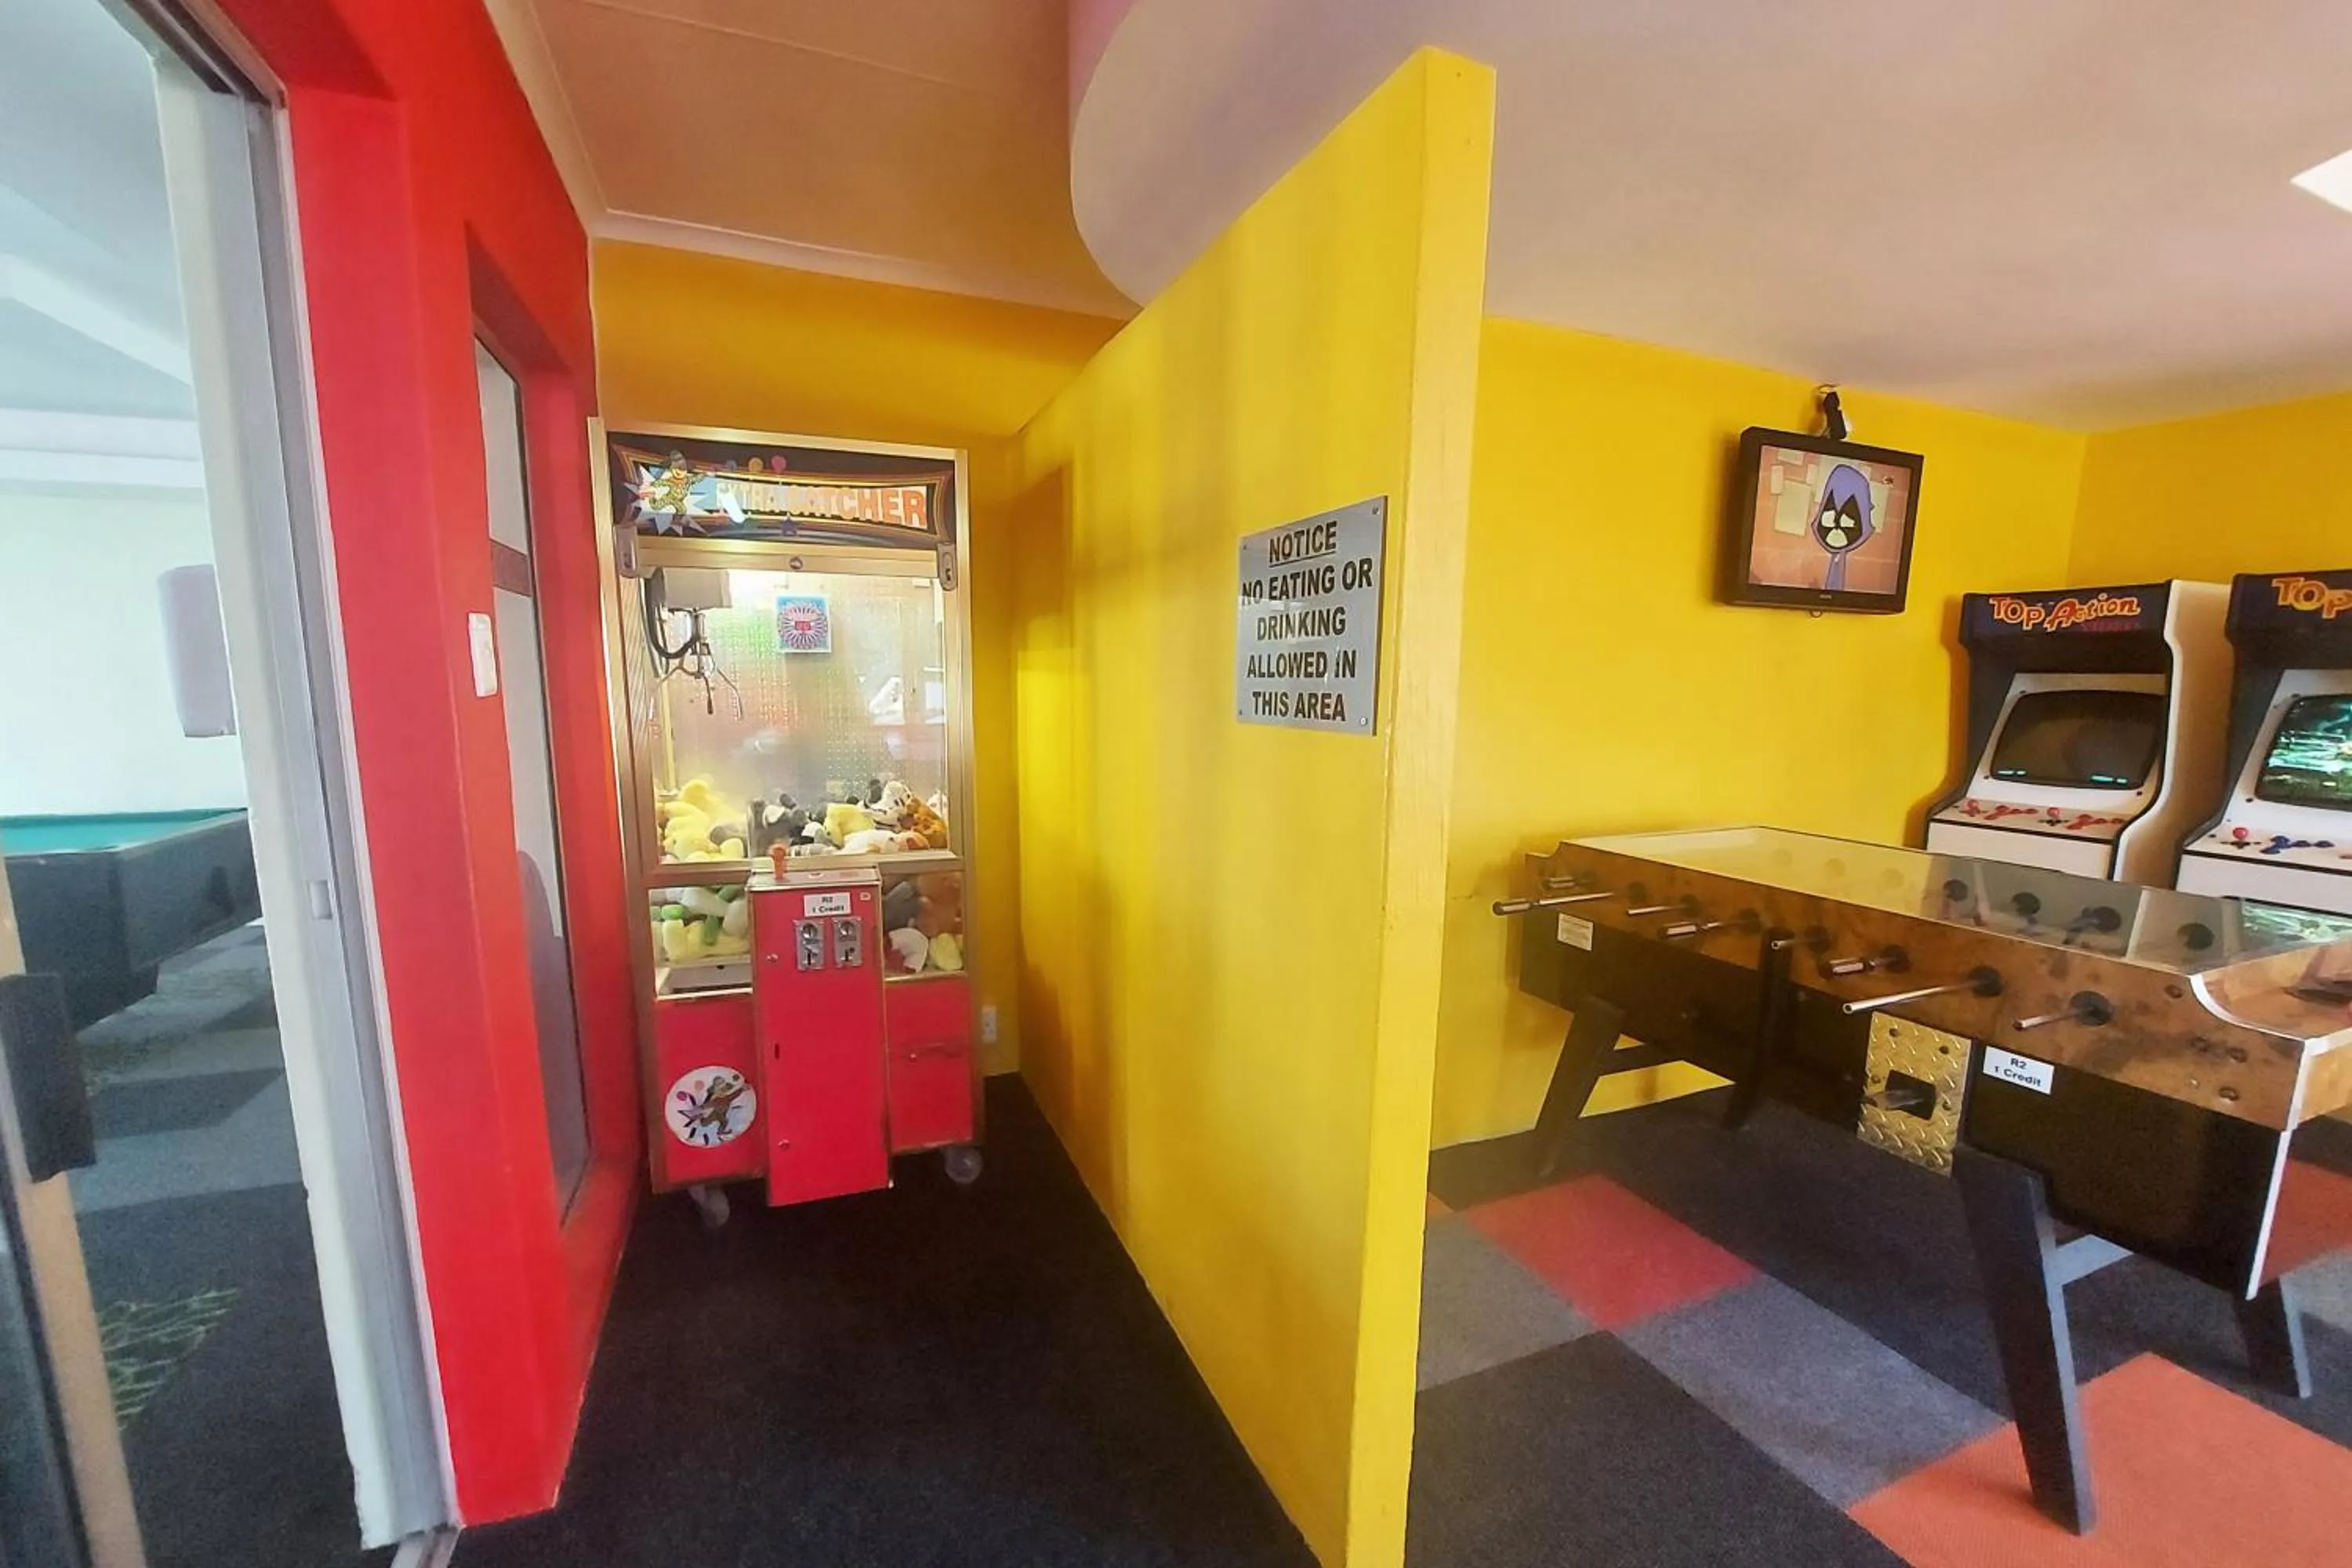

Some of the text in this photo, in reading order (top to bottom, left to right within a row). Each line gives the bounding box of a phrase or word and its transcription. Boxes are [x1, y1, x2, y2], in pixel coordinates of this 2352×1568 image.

[1269, 521, 1338, 563] NOTICE
[1241, 557, 1374, 606] NO EATING OR
[1257, 607, 1346, 641] DRINKING
[2043, 593, 2140, 632] Action
[1247, 649, 1357, 678] ALLOWED IN
[1252, 691, 1346, 721] THIS AREA
[818, 905, 844, 913] Credit
[2003, 1068, 2042, 1087] Credit
[2010, 1058, 2027, 1069] R2
